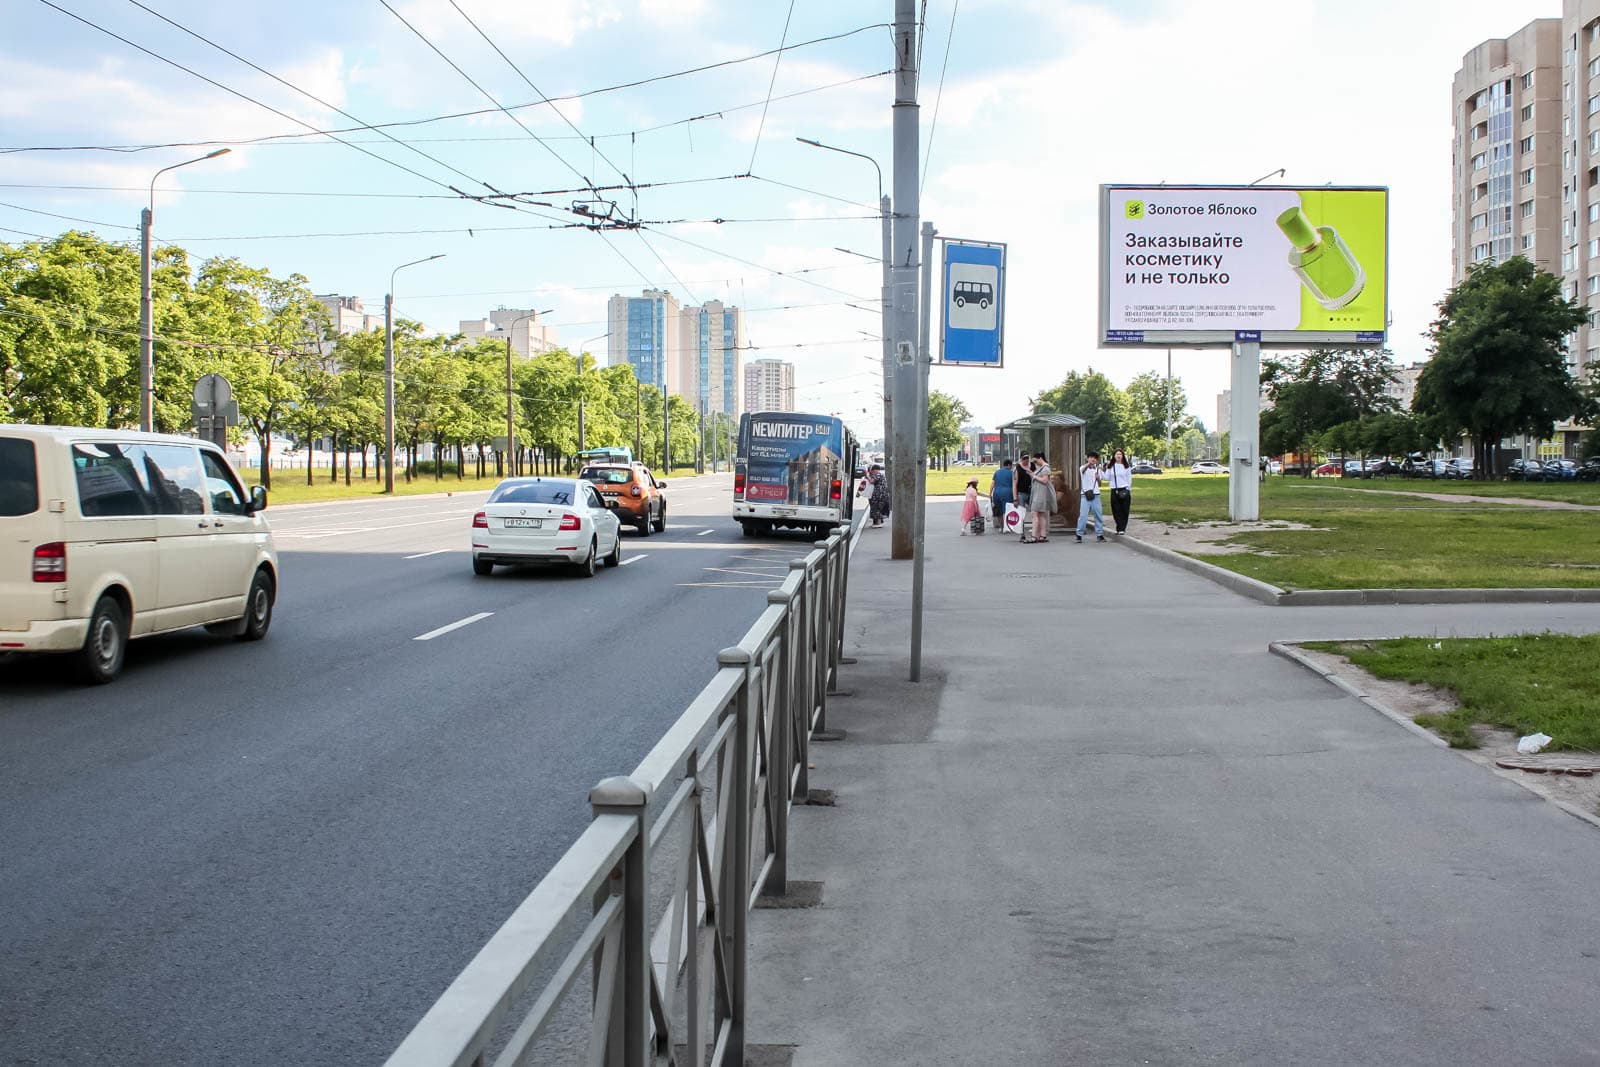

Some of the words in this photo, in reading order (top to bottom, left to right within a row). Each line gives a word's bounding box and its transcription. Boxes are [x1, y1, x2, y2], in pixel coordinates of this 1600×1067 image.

[1148, 203, 1205, 216] Золотое
[1207, 203, 1257, 216] Яблоко
[1125, 233, 1243, 249] Заказывайте
[1125, 253, 1223, 269] косметику
[1125, 273, 1136, 284] и
[1141, 273, 1163, 284] не
[1169, 273, 1230, 284] только
